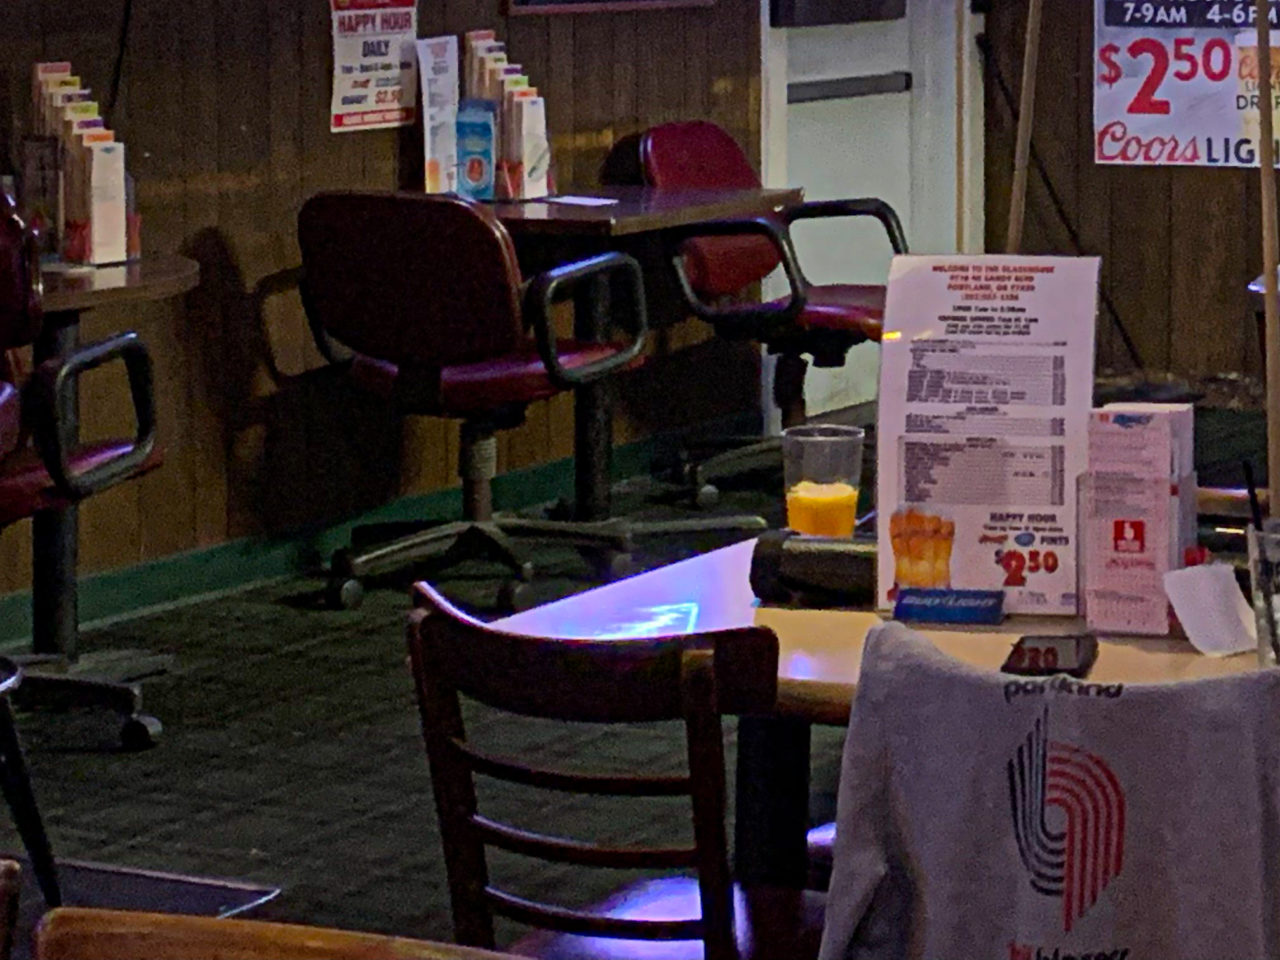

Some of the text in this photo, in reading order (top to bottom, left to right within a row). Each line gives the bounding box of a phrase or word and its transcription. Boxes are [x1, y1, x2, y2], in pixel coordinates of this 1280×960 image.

[337, 11, 412, 33] HAPPY HOUR
[1122, 3, 1188, 24] 7-9AM
[1096, 120, 1201, 163] Coors
[989, 512, 1057, 523] HAPPY HOUR
